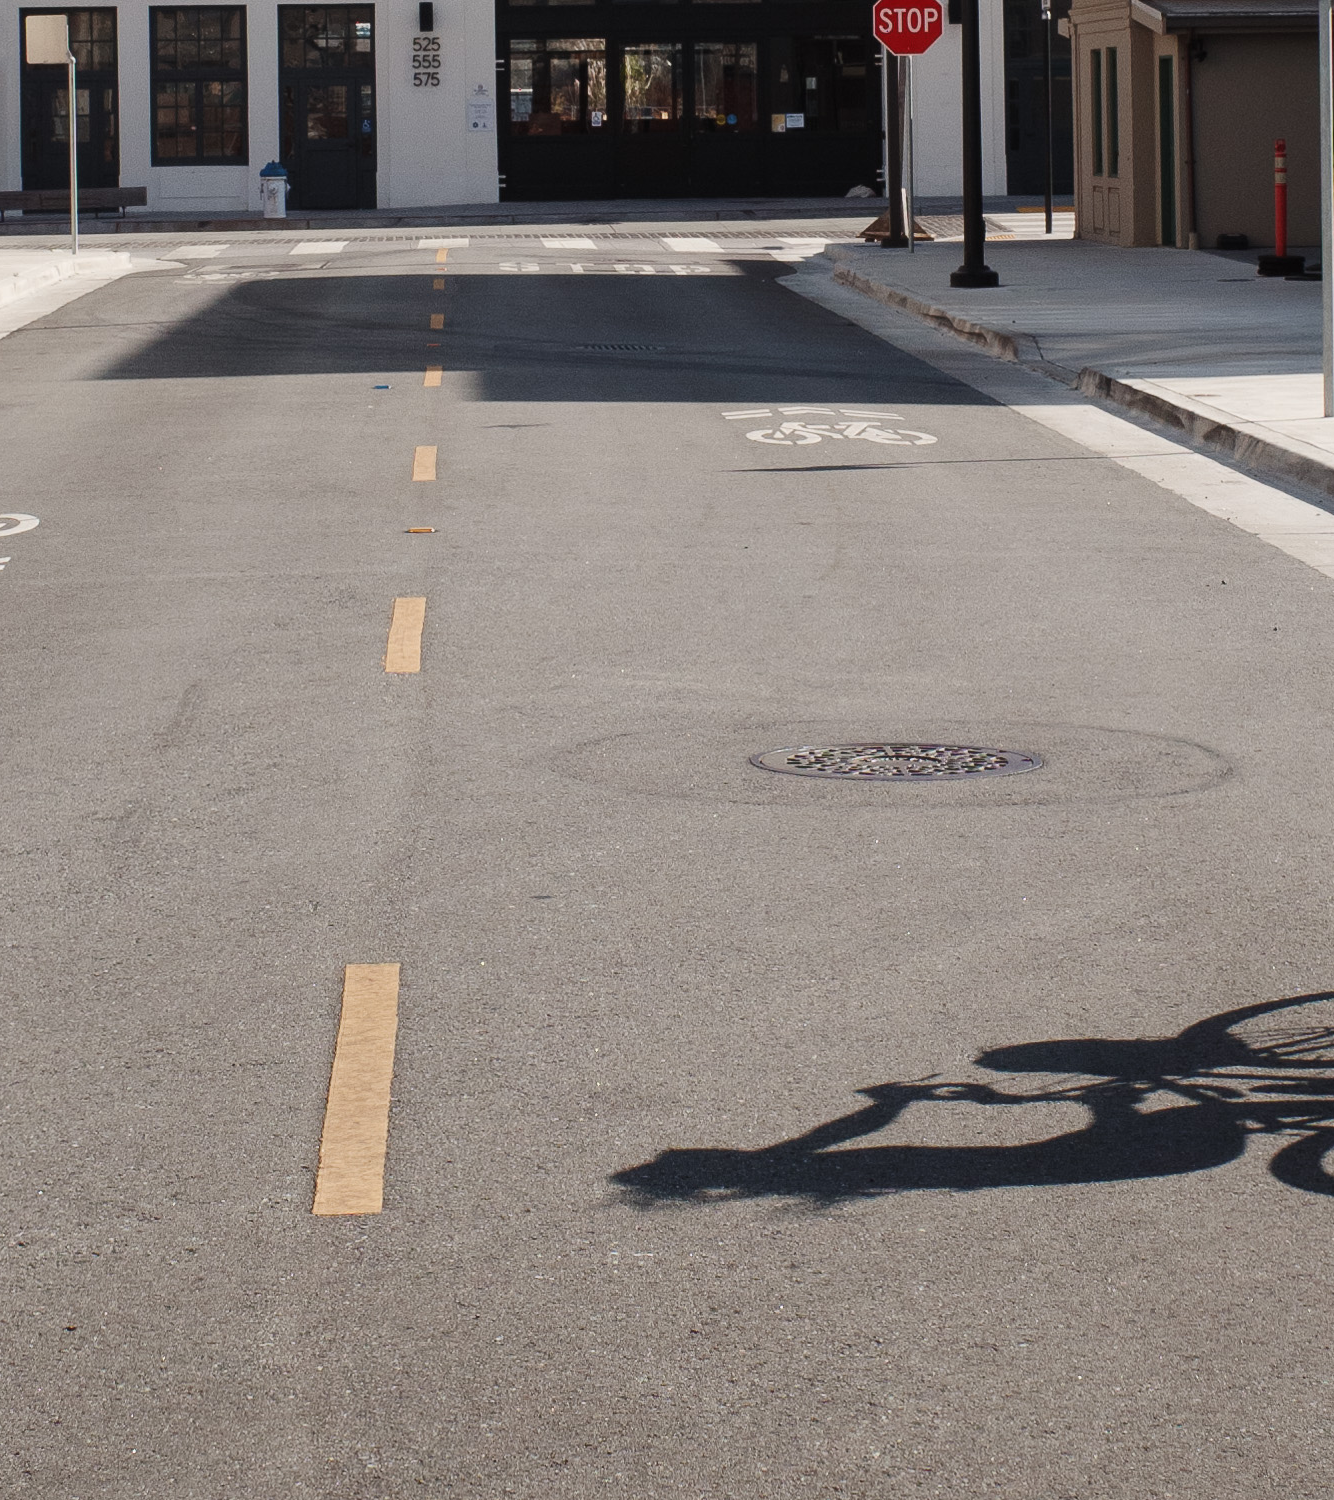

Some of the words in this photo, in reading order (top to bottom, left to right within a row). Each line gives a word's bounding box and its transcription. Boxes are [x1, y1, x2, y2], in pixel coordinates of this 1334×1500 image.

[878, 7, 938, 33] STOP
[412, 37, 441, 51] 525
[412, 54, 441, 69] 555
[413, 72, 440, 87] 575
[499, 262, 711, 276] STOP
